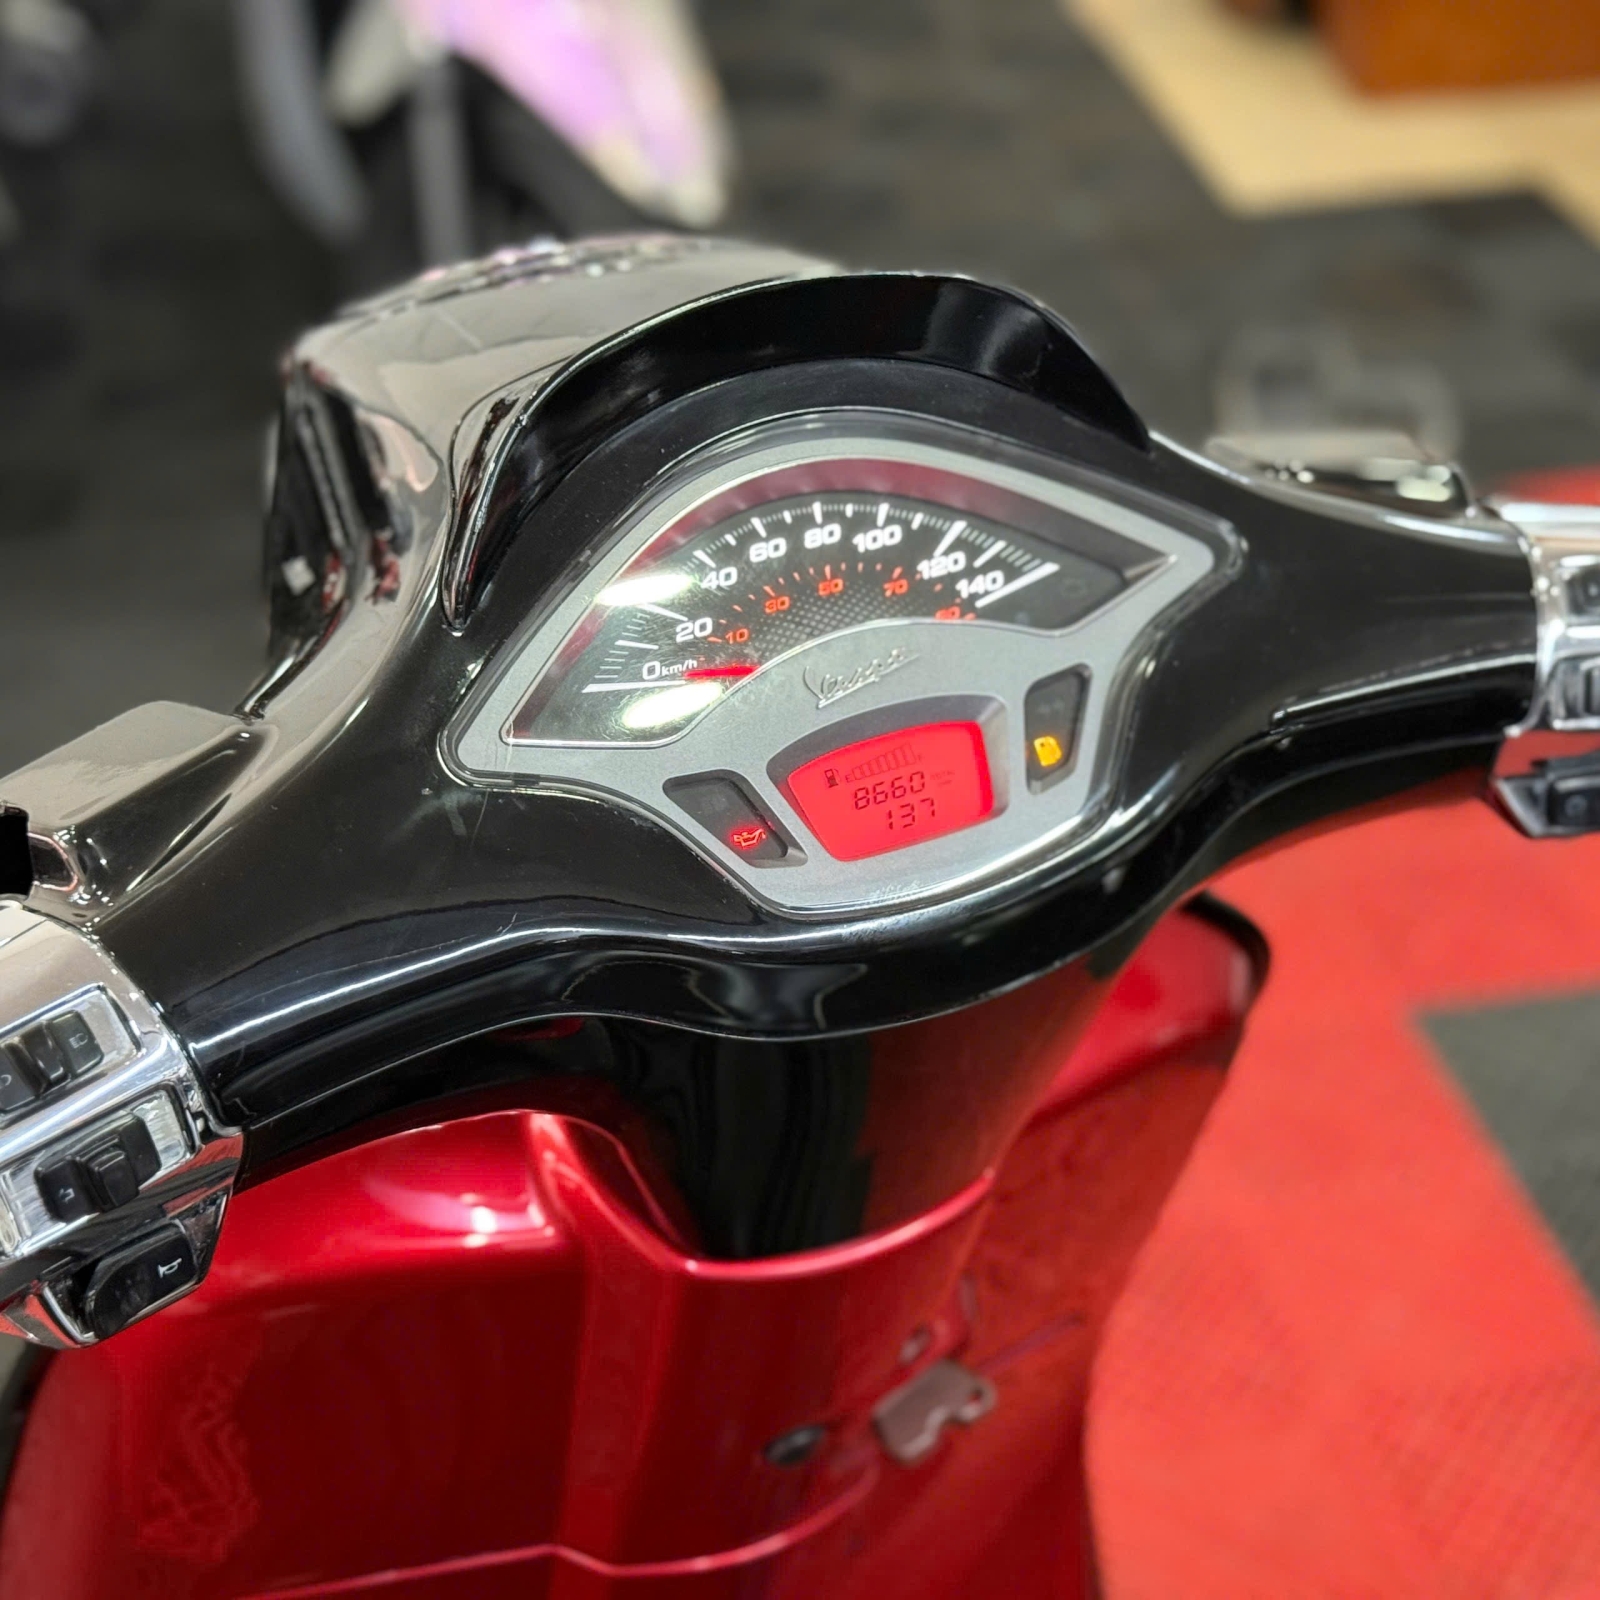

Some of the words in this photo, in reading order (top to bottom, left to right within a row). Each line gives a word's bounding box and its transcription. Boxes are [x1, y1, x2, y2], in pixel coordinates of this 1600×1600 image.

[803, 523, 842, 549] 80
[852, 524, 902, 553] 100
[749, 538, 787, 563] 60
[699, 566, 738, 590] 40
[916, 551, 966, 580] 120
[883, 578, 908, 597] 70
[955, 570, 1005, 598] 140
[764, 596, 790, 615] 30
[675, 617, 713, 643] 20
[725, 628, 749, 644] 10
[642, 661, 661, 680] 0
[661, 659, 698, 677] km/h
[802, 646, 919, 709] Vespa
[854, 771, 925, 811] 8660
[886, 797, 936, 831] 137
